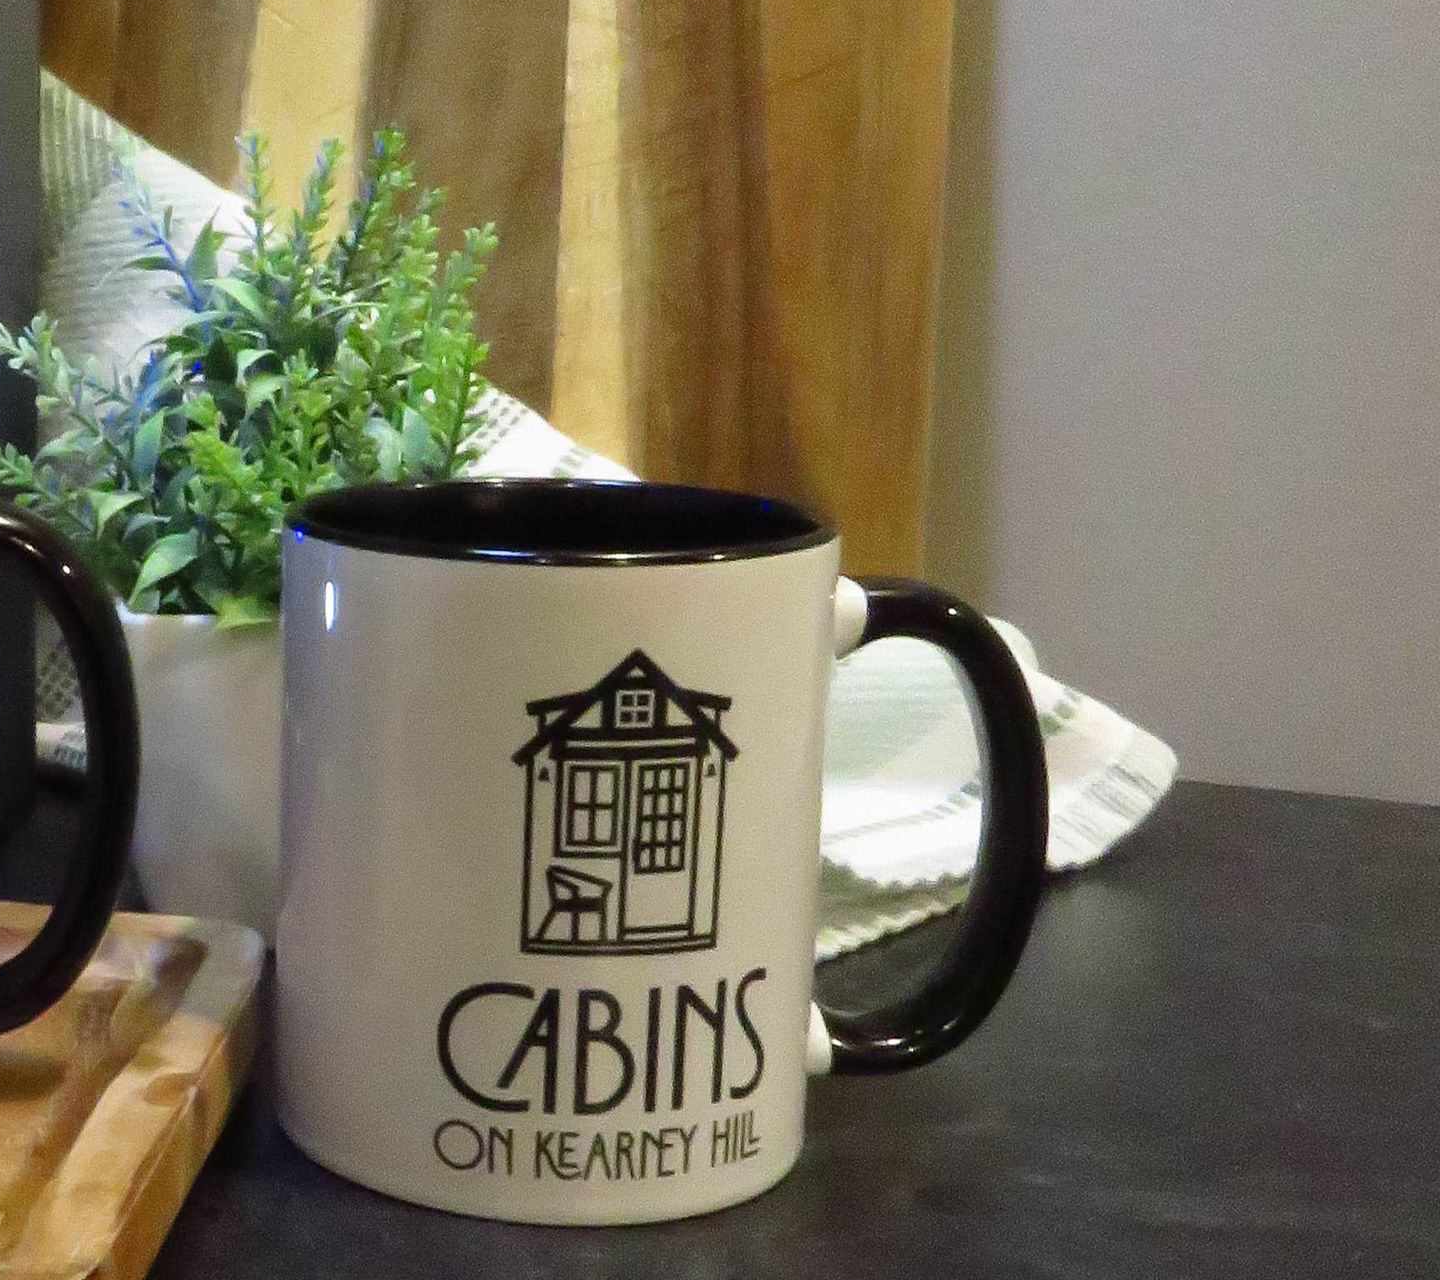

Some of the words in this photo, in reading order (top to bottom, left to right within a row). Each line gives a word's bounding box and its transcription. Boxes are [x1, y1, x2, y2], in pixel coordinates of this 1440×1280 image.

[436, 967, 767, 1115] CABINS
[433, 1120, 513, 1176] ON
[534, 1124, 698, 1181] KEARNEY
[711, 1110, 762, 1168] HILL
